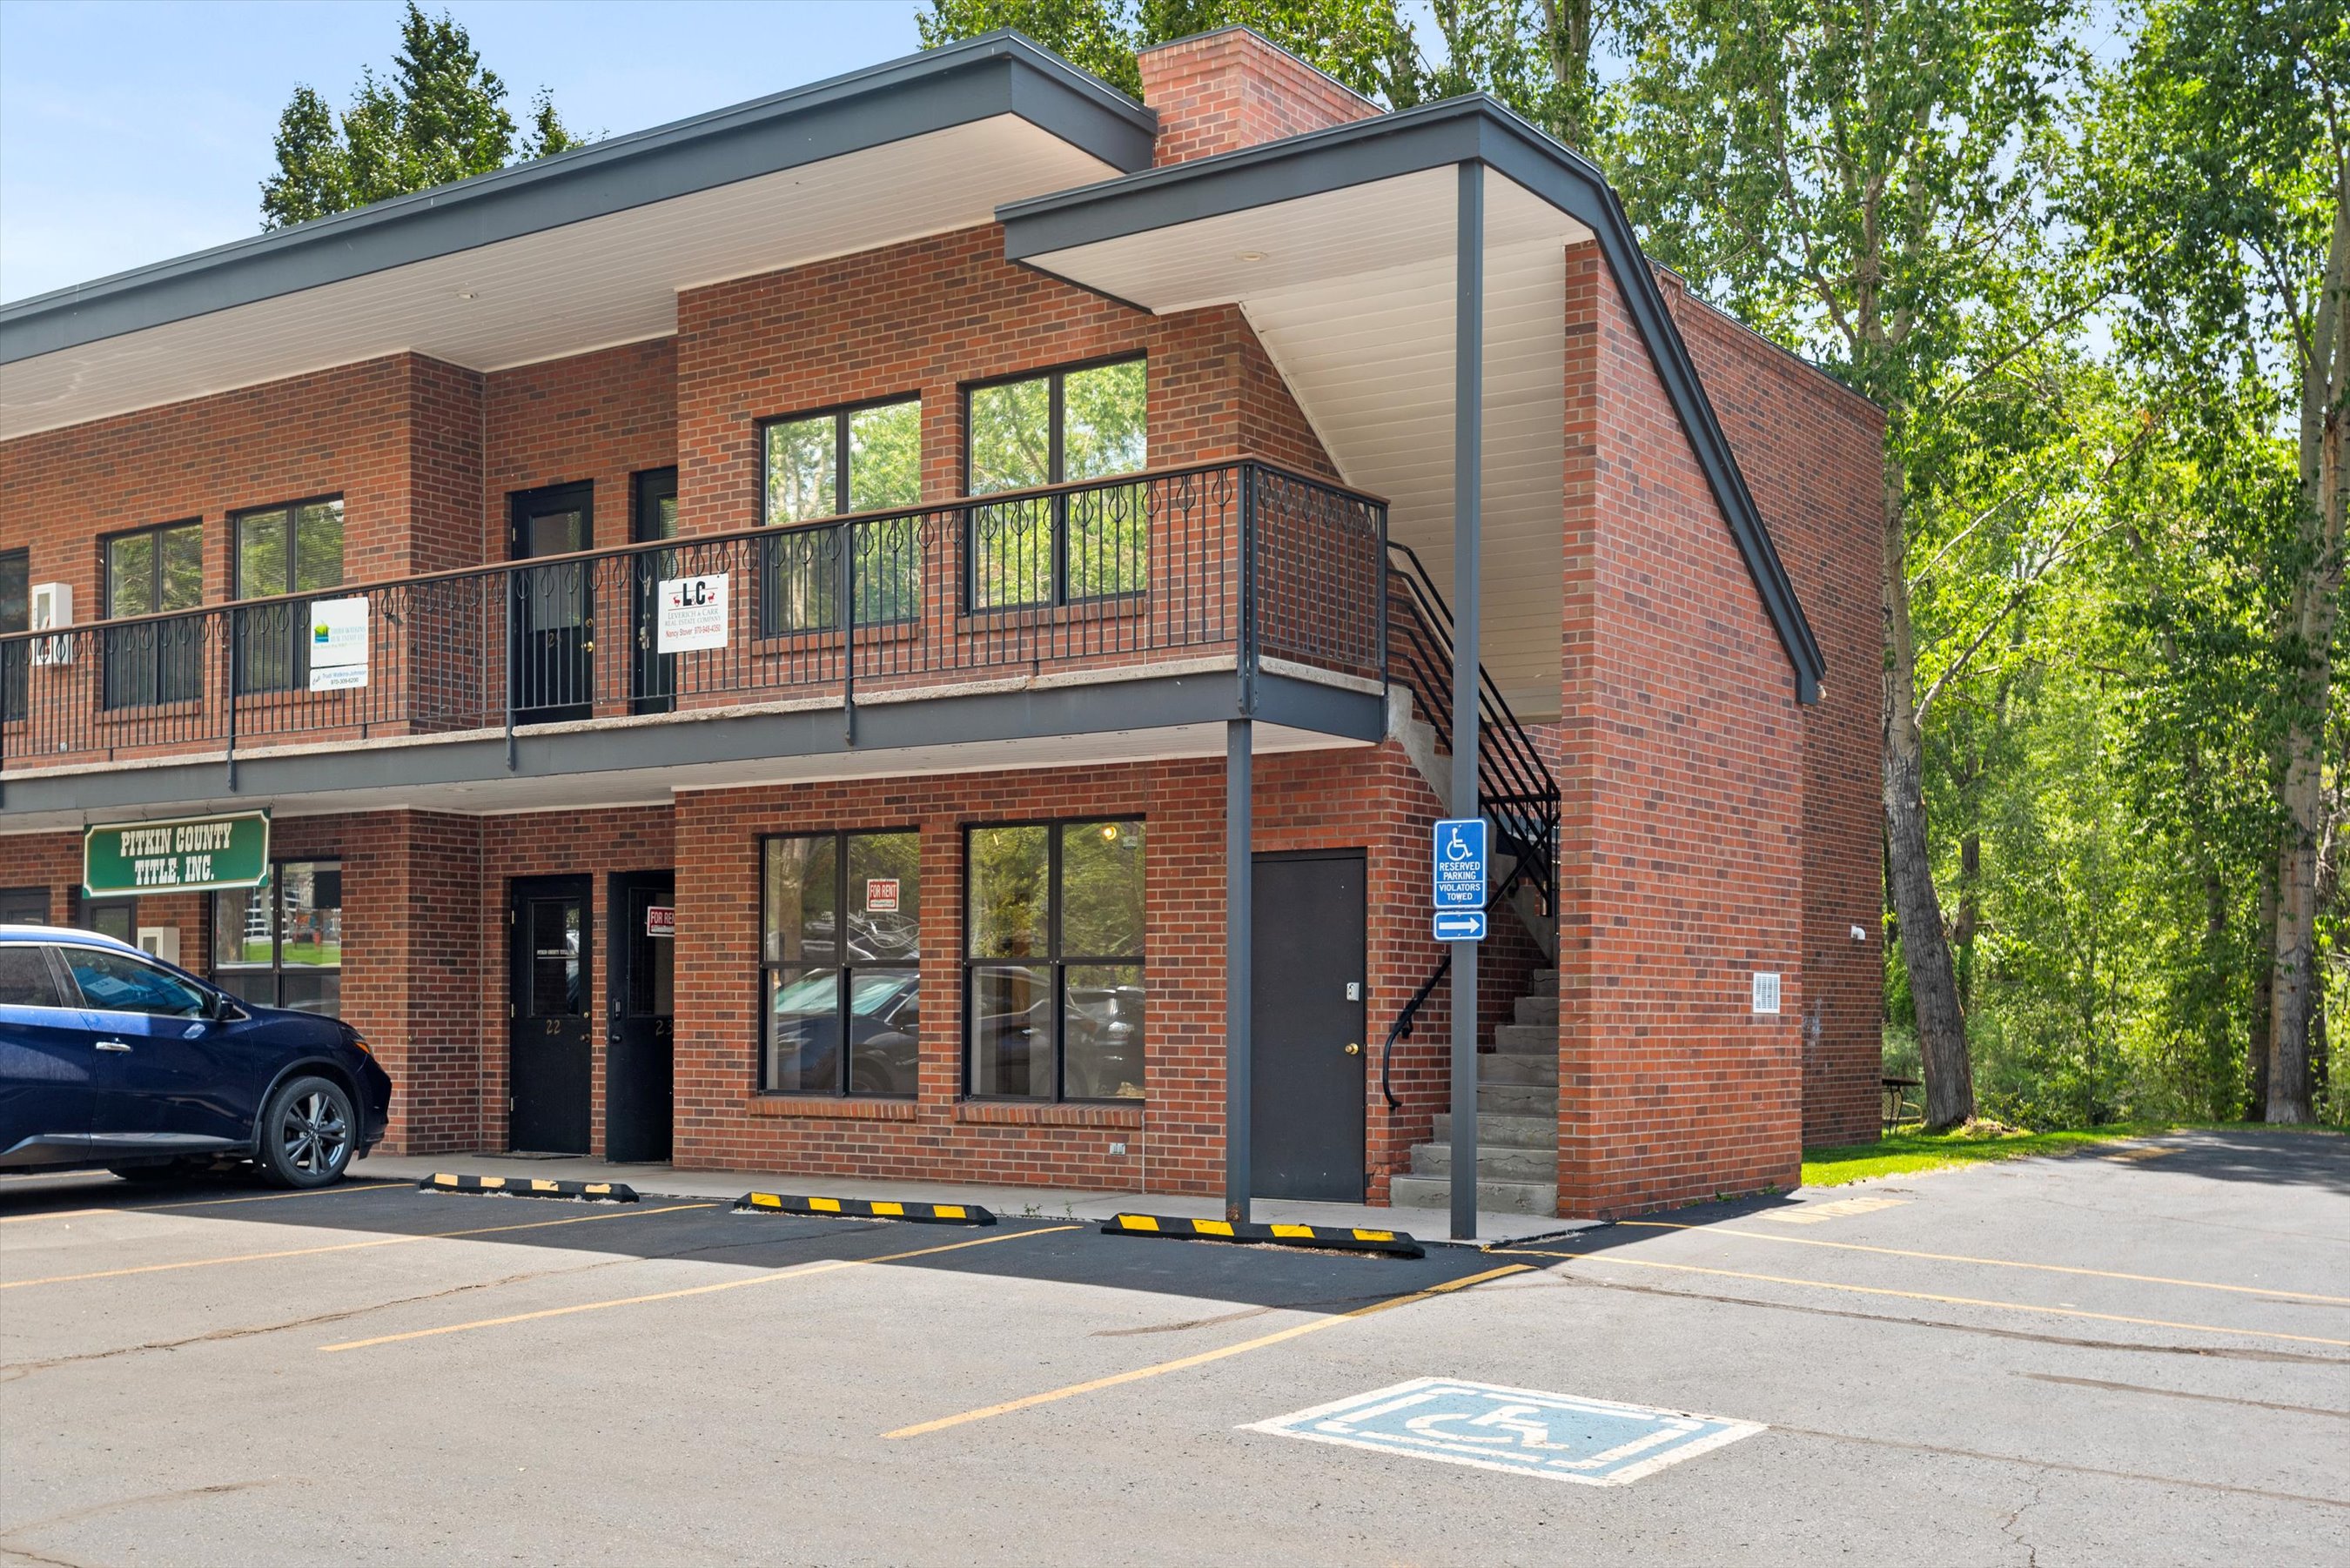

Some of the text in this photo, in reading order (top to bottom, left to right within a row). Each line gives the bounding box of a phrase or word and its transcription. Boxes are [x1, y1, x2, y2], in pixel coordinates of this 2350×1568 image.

[668, 610, 695, 620] LEVERICH
[666, 629, 679, 639] Nancy
[120, 822, 232, 857] PITKIN COUNTY
[135, 854, 214, 886] TITLE, INC.
[1439, 861, 1480, 871] RESERVED
[1443, 871, 1476, 881] PARKING
[870, 884, 896, 897] FOR RENT
[1439, 883, 1480, 892] VIOLATORS
[1447, 892, 1473, 901] TOWED
[650, 911, 663, 924] FOR
[546, 1019, 561, 1035] 22
